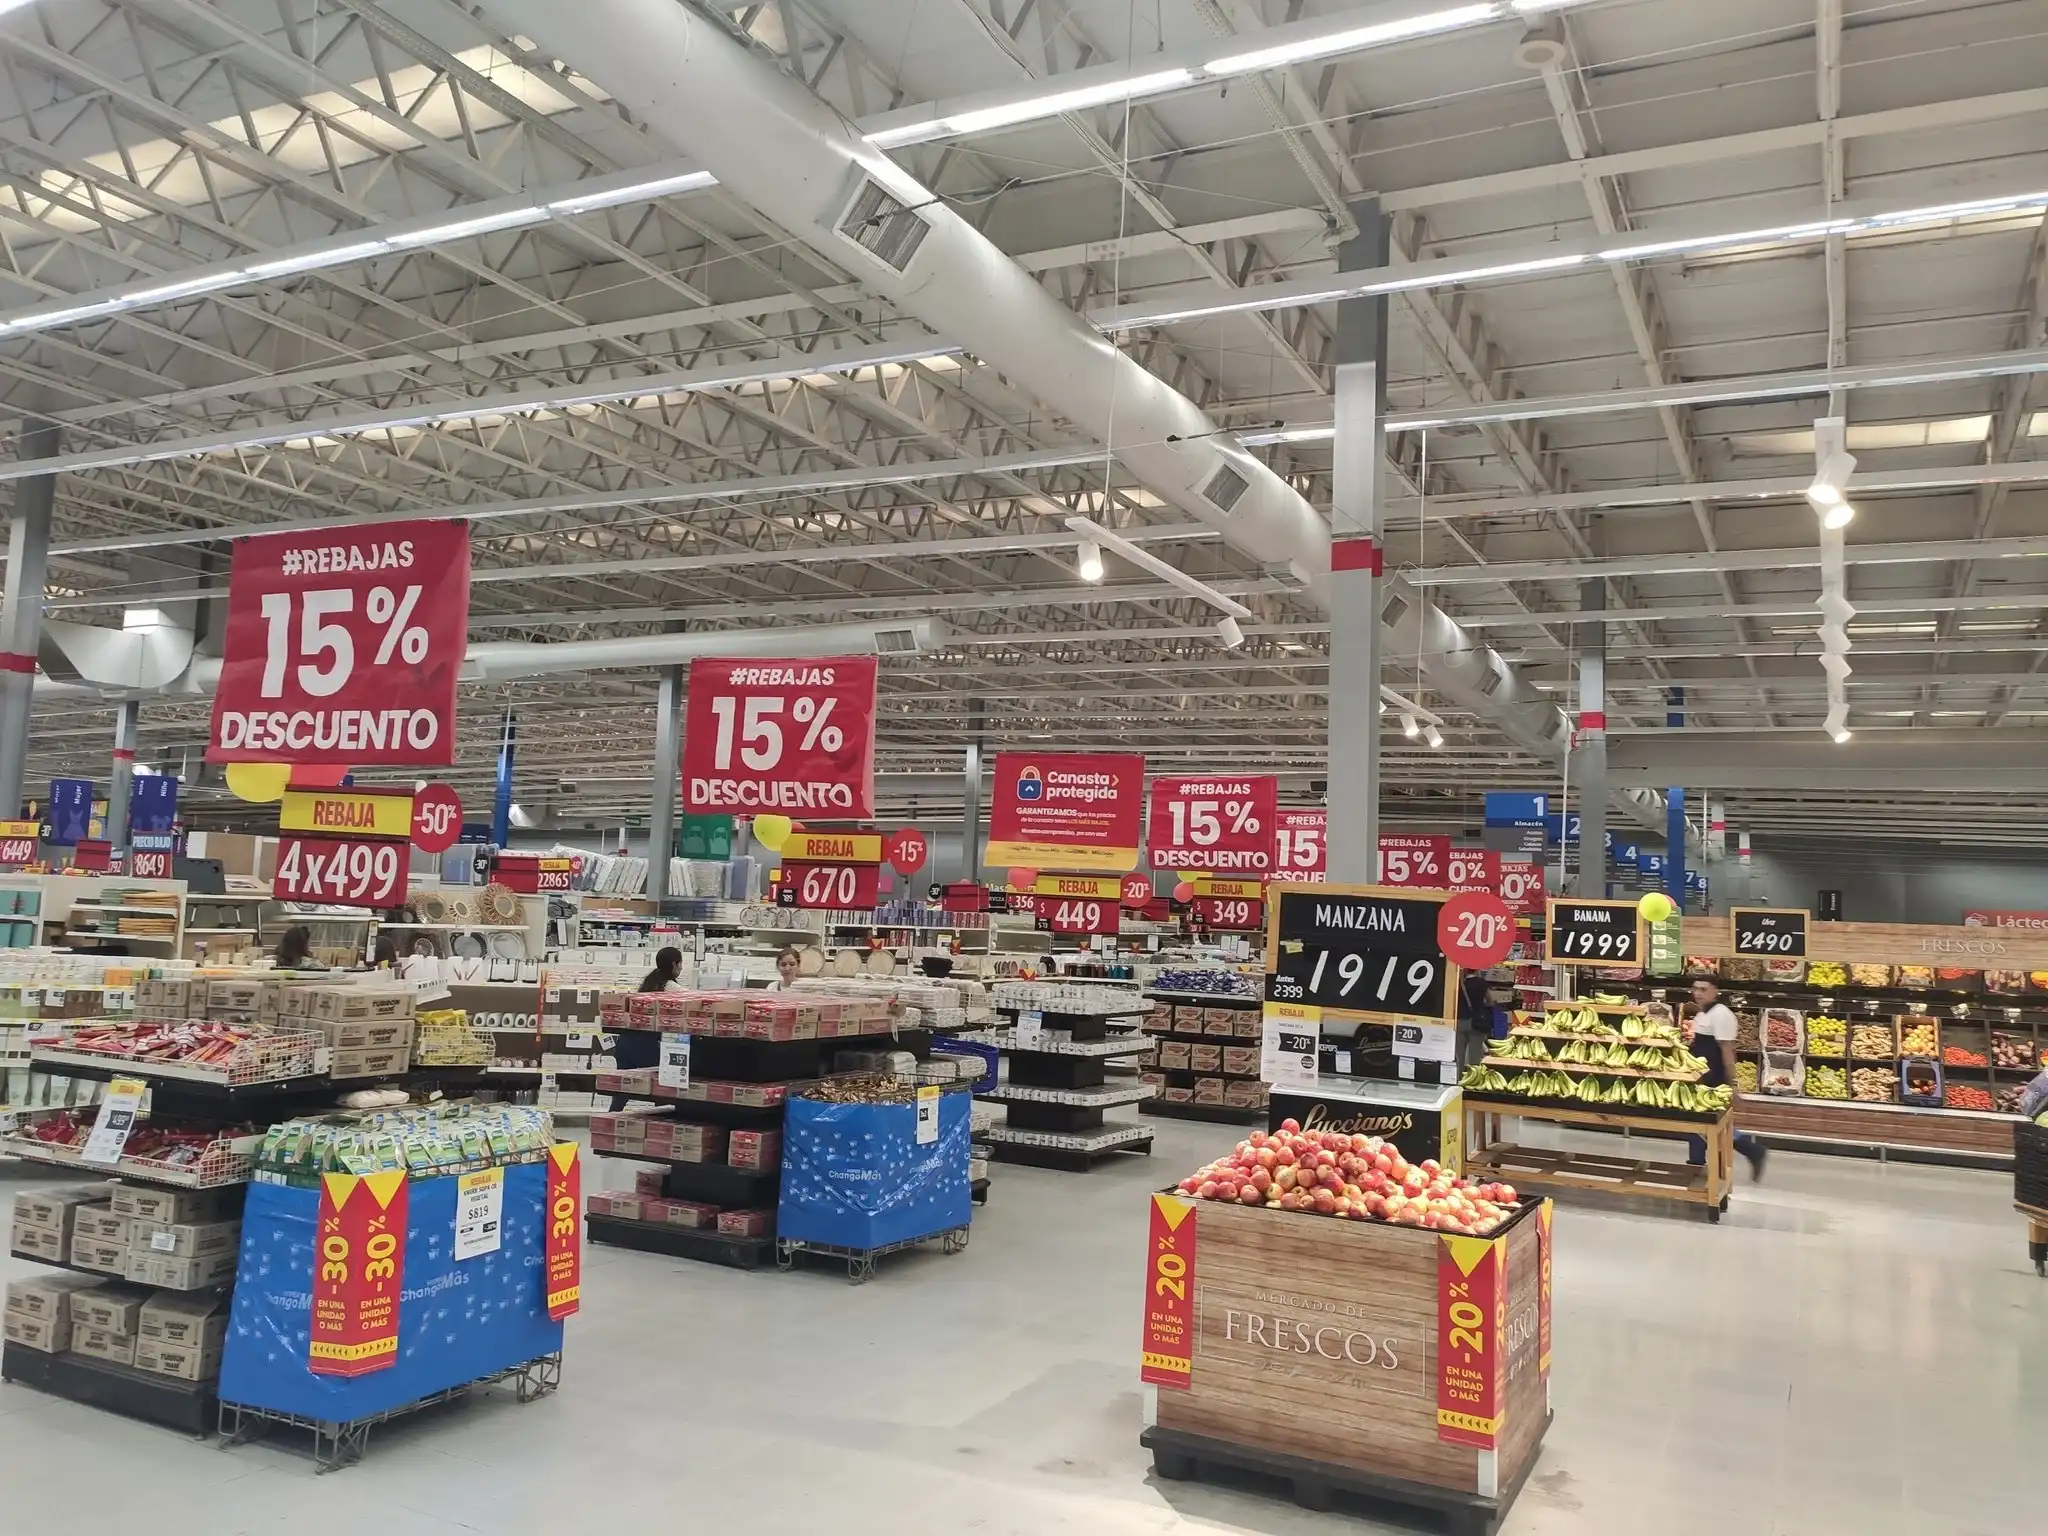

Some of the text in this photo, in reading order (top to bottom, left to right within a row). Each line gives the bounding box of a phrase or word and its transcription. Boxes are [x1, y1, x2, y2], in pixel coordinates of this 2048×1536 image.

[282, 541, 414, 575] #REBAJAS
[261, 585, 429, 698] 15%
[729, 668, 835, 686] #REBAJAS
[221, 709, 438, 751] DESCUENTO
[711, 696, 844, 771] 15%
[1048, 771, 1109, 785] Canasta
[74, 785, 82, 804] Mujer
[691, 778, 852, 809] DESCUENTO
[1046, 786, 1117, 803] protegida
[1179, 783, 1250, 795] #REBAJAS
[313, 800, 376, 827] REBAJA
[1016, 807, 1077, 817] GARANTIZAMOS
[1533, 796, 1544, 817] 1
[414, 802, 457, 835] -50%
[1169, 800, 1260, 845] 15%
[1570, 818, 1580, 834] 2
[133, 836, 171, 848] PRECIO BAJO
[807, 839, 854, 857] REBAJA
[1276, 830, 1327, 867] 15
[1379, 838, 1432, 848] #REBAJAS
[894, 841, 923, 862] -15%
[1154, 850, 1269, 869] DESCUENTO
[1450, 852, 1483, 860] EBAJAS
[1625, 846, 1637, 859] 4
[279, 841, 397, 900] 4x499
[1650, 857, 1660, 869] 5
[538, 872, 569, 887] 22865
[1449, 861, 1486, 883] 0%
[1685, 872, 1694, 882] 7
[803, 867, 856, 903] 670
[1059, 880, 1098, 894] REBAJA
[1124, 882, 1149, 898] -20%
[1211, 884, 1243, 895] REBAJA
[1698, 878, 1707, 888] 8
[1015, 896, 1034, 908] 356
[1055, 901, 1101, 930] 449
[1213, 901, 1249, 924] 349
[1315, 904, 1405, 933] MANZANA
[1574, 910, 1611, 924] BANANA
[1448, 912, 1507, 948] -20%
[1564, 931, 1631, 957] 1999
[1740, 931, 1793, 951] 2490
[1922, 938, 2007, 955] FRESCOS
[1276, 974, 1295, 983] Antes
[1309, 950, 1434, 1005] 1919
[1274, 985, 1303, 998] 2399
[1279, 1007, 1305, 1018] REBAJA
[1286, 1037, 1311, 1050] -20%
[1302, 1103, 1413, 1139] Lucciano's
[468, 1205, 489, 1220] $819
[553, 1180, 575, 1248] -30%
[322, 1217, 349, 1294] -30%
[365, 1216, 396, 1292] -30%
[551, 1252, 574, 1262] EN UNA
[551, 1260, 574, 1272] UNIDAD
[1156, 1236, 1186, 1310] -20%
[318, 1300, 328, 1308] EN
[329, 1301, 345, 1310] UNA
[361, 1297, 391, 1309] EN UNA
[1256, 1291, 1366, 1318] MERCADO DE
[317, 1310, 345, 1320] UNIDAD
[359, 1307, 391, 1320] UNIDAD
[1151, 1312, 1183, 1324] EN UNA
[319, 1321, 325, 1329] O
[362, 1317, 387, 1330] O MÁS
[1151, 1322, 1183, 1335] UNIDAD
[1449, 1282, 1484, 1363] -20%
[1162, 1333, 1180, 1345] MÁS
[1224, 1309, 1399, 1370] FRESCOS
[1446, 1365, 1483, 1380] EN UNA
[1446, 1377, 1484, 1392] UNIDAD
[1449, 1389, 1480, 1403] O MÁS
